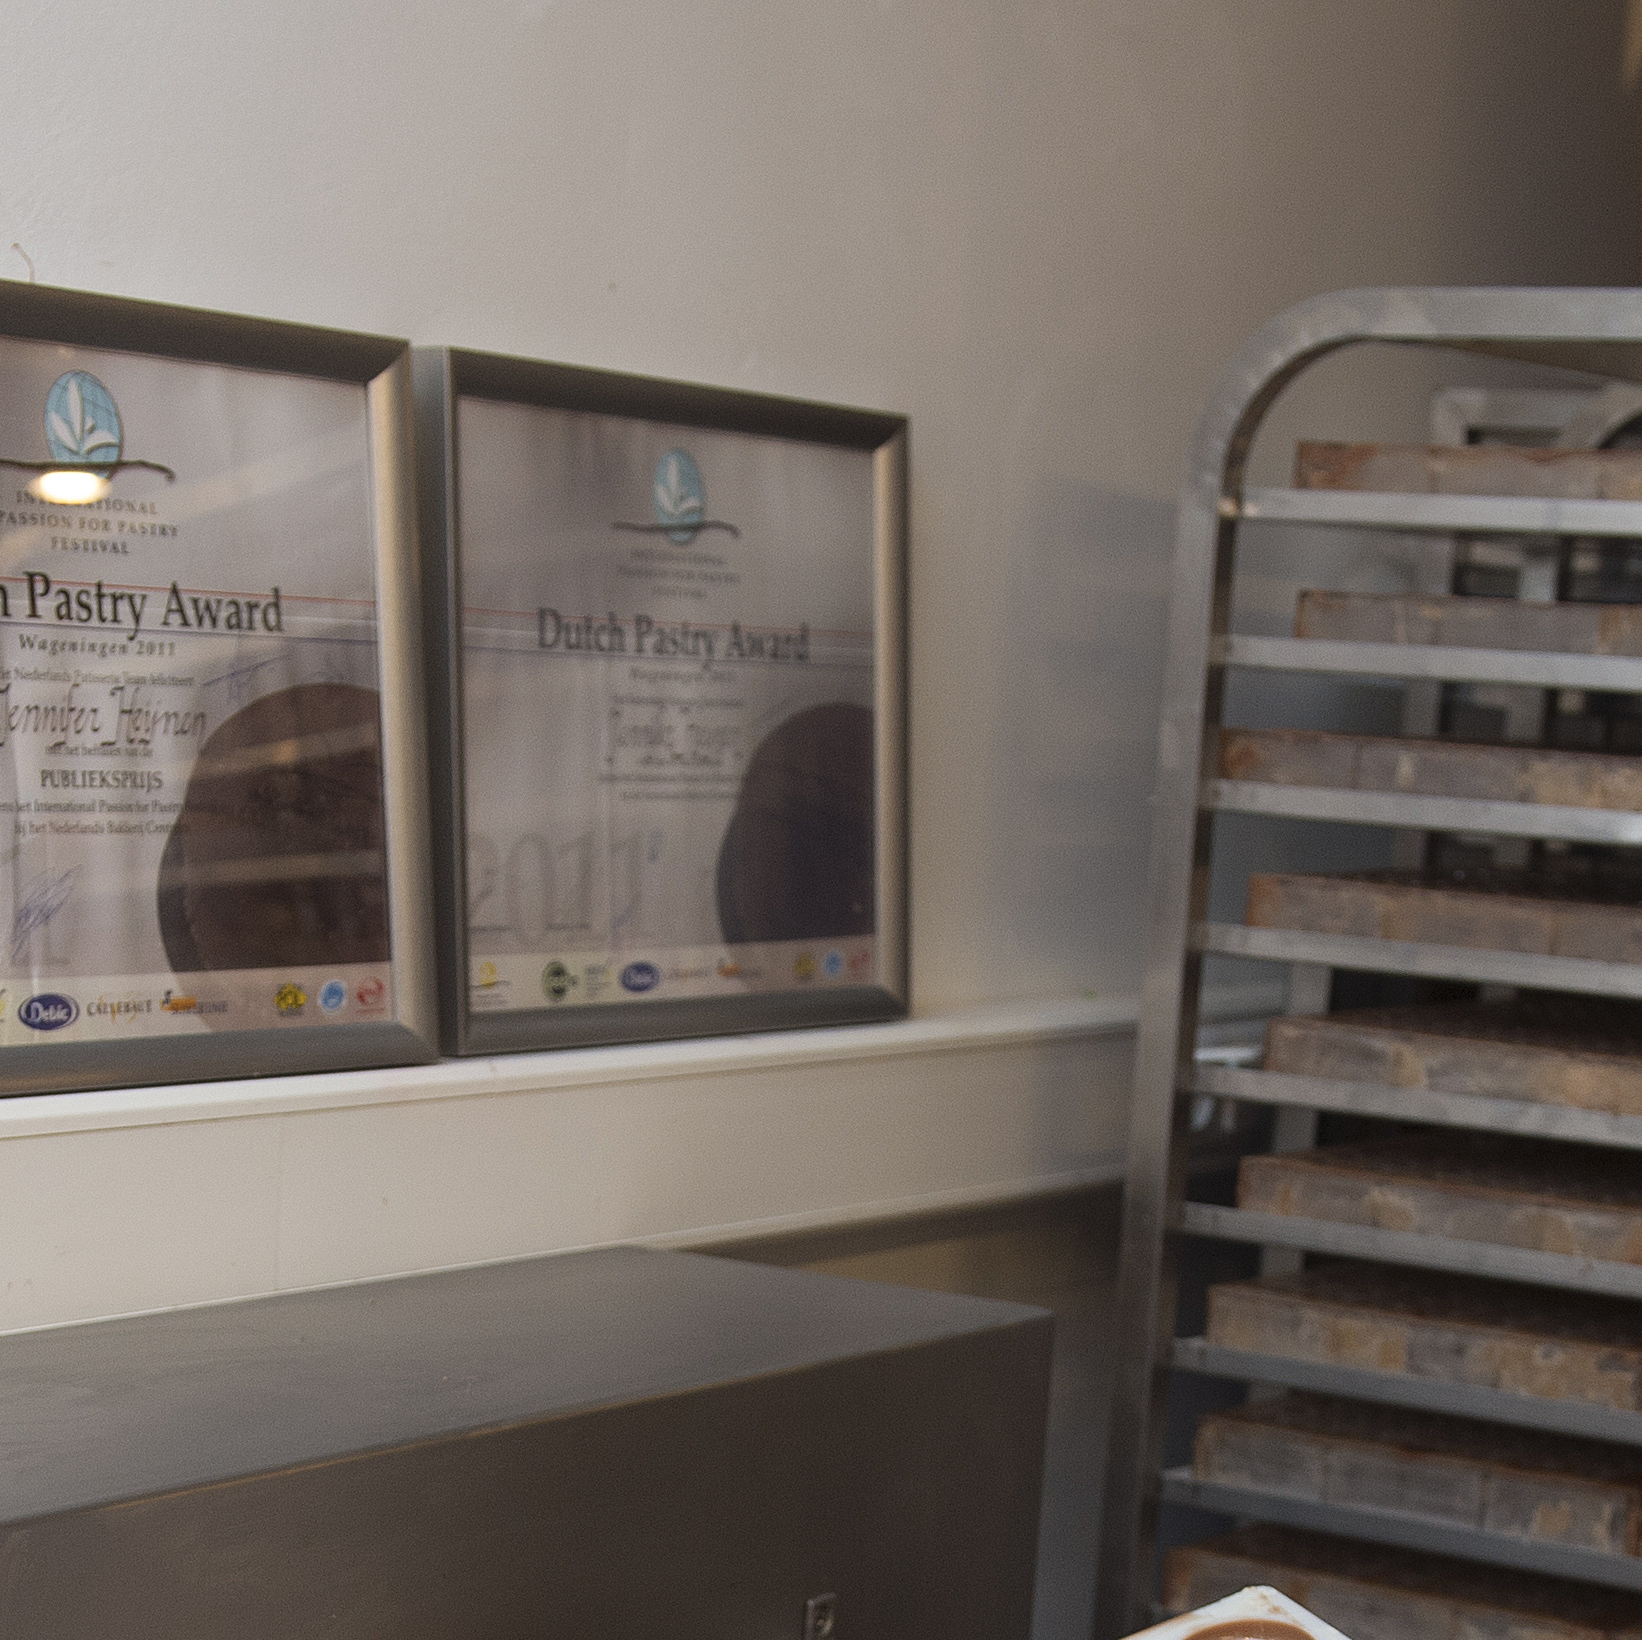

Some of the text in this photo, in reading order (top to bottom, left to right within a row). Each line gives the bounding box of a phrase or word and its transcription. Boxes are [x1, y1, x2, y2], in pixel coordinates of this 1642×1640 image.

[78, 516, 112, 532] FOR
[117, 519, 179, 537] PASTRY
[23, 570, 148, 641] Pastry
[161, 580, 285, 633] Award
[18, 633, 177, 658] Wageningen 2011
[537, 607, 812, 671] Dutch Pastry Award
[40, 768, 164, 794] PUBLIEKSPRIJS
